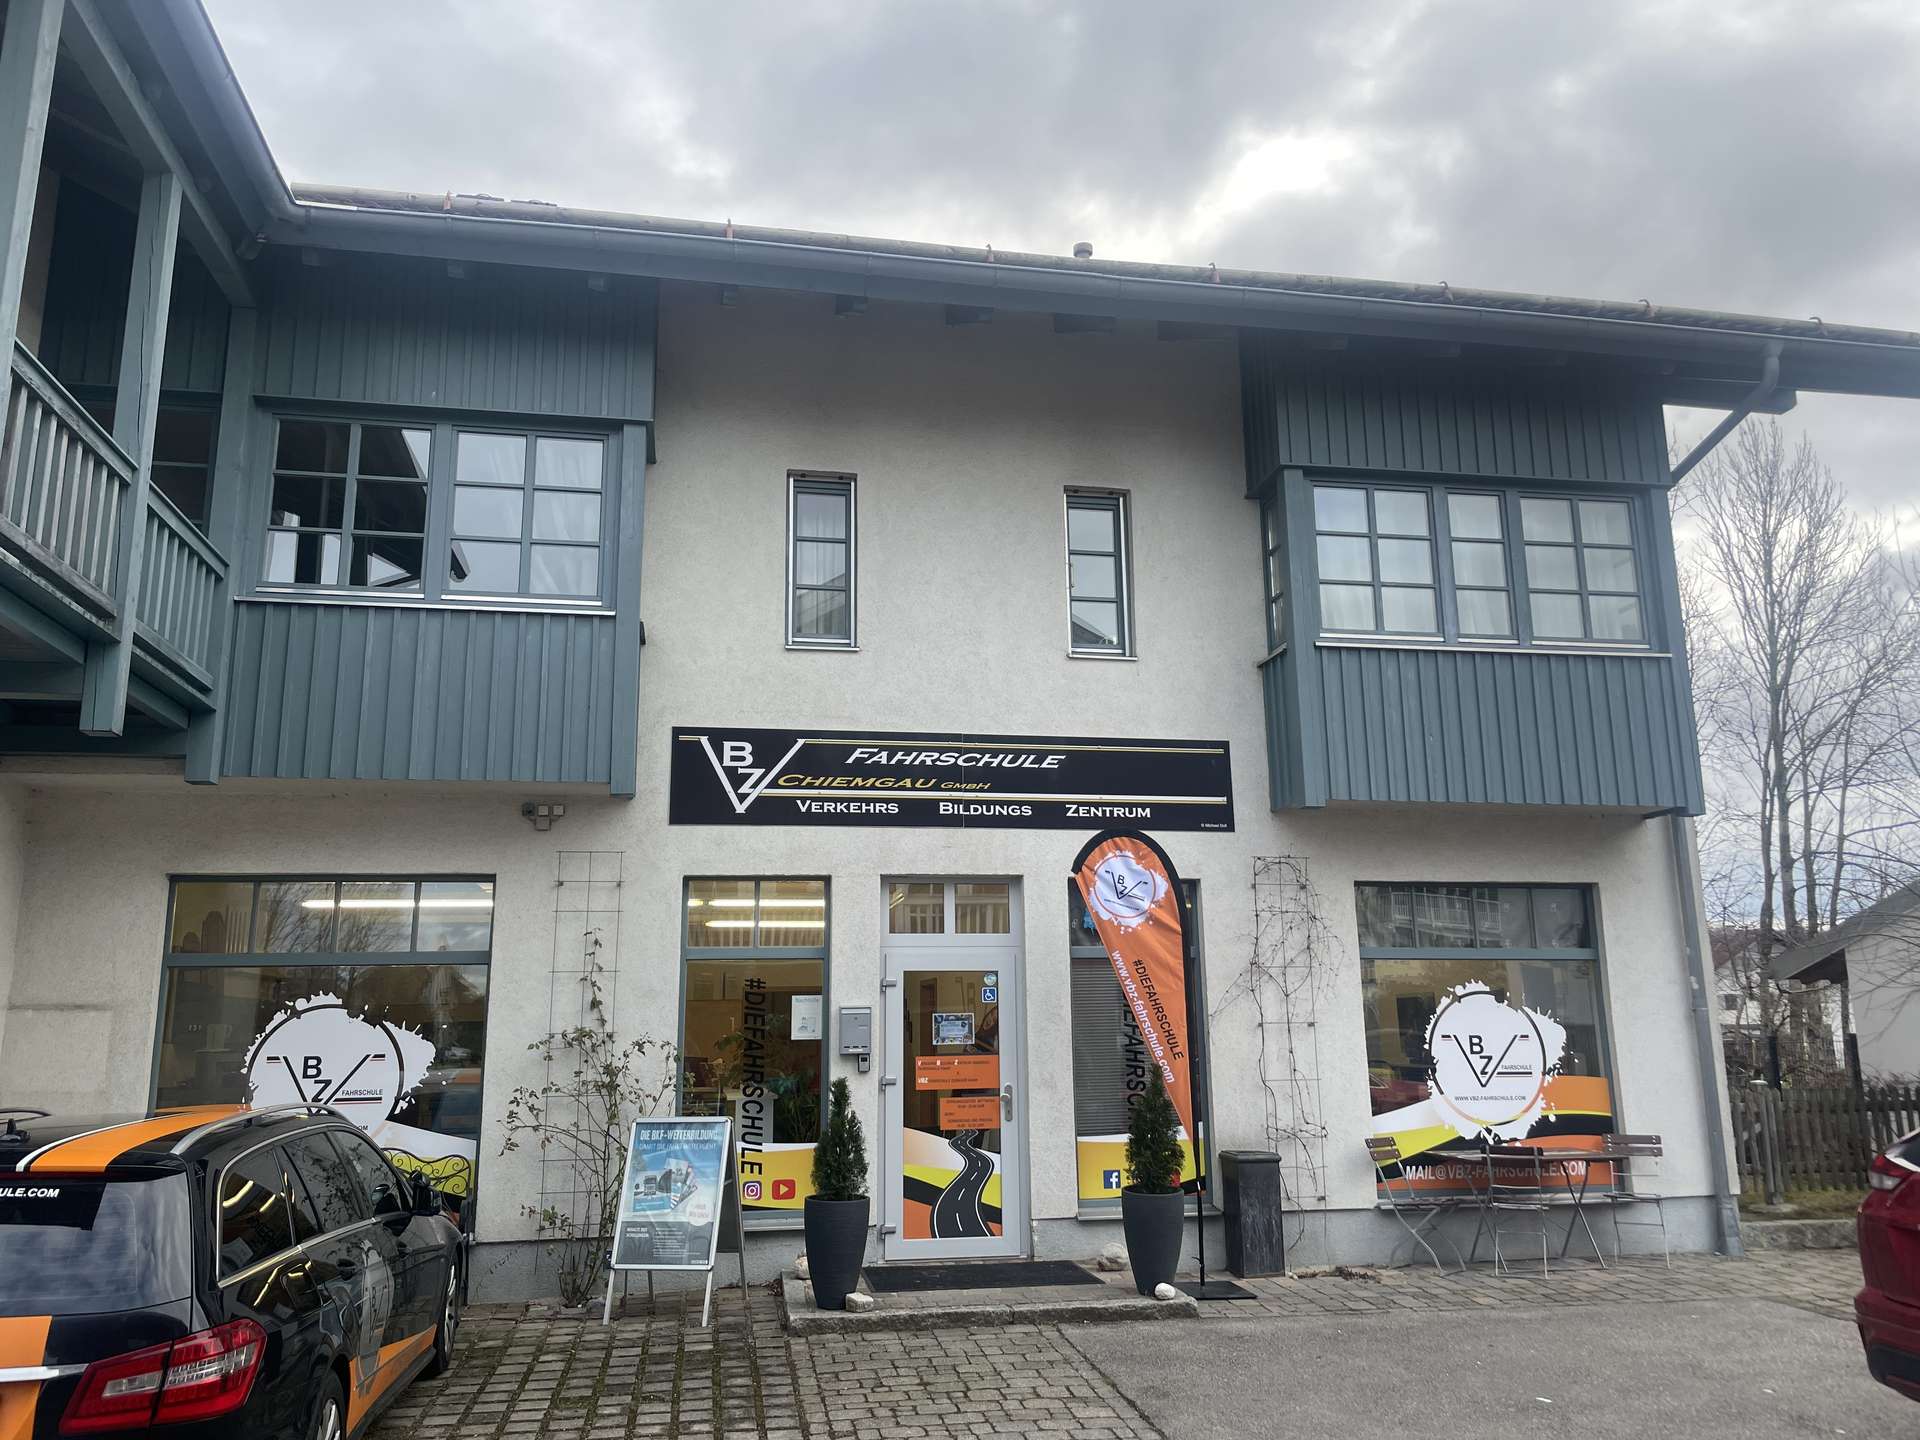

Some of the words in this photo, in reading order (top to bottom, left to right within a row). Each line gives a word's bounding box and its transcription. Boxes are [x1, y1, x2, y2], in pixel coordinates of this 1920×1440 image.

[845, 748, 1066, 769] FAHRSCHULE
[777, 774, 937, 789] CHIEMGAU
[796, 799, 899, 814] VERKEHRS
[939, 802, 1033, 816] BILDUNGS
[1065, 804, 1151, 818] ZENTRUM
[1112, 950, 1176, 1084] www.vbz-fahrschule.com
[1132, 959, 1184, 1061] #DIEFAHRSCHULE
[741, 977, 767, 1176] #DIEFAHRSCHULE
[341, 1088, 383, 1096] FAHRSCHULE
[640, 1129, 651, 1141] DIE
